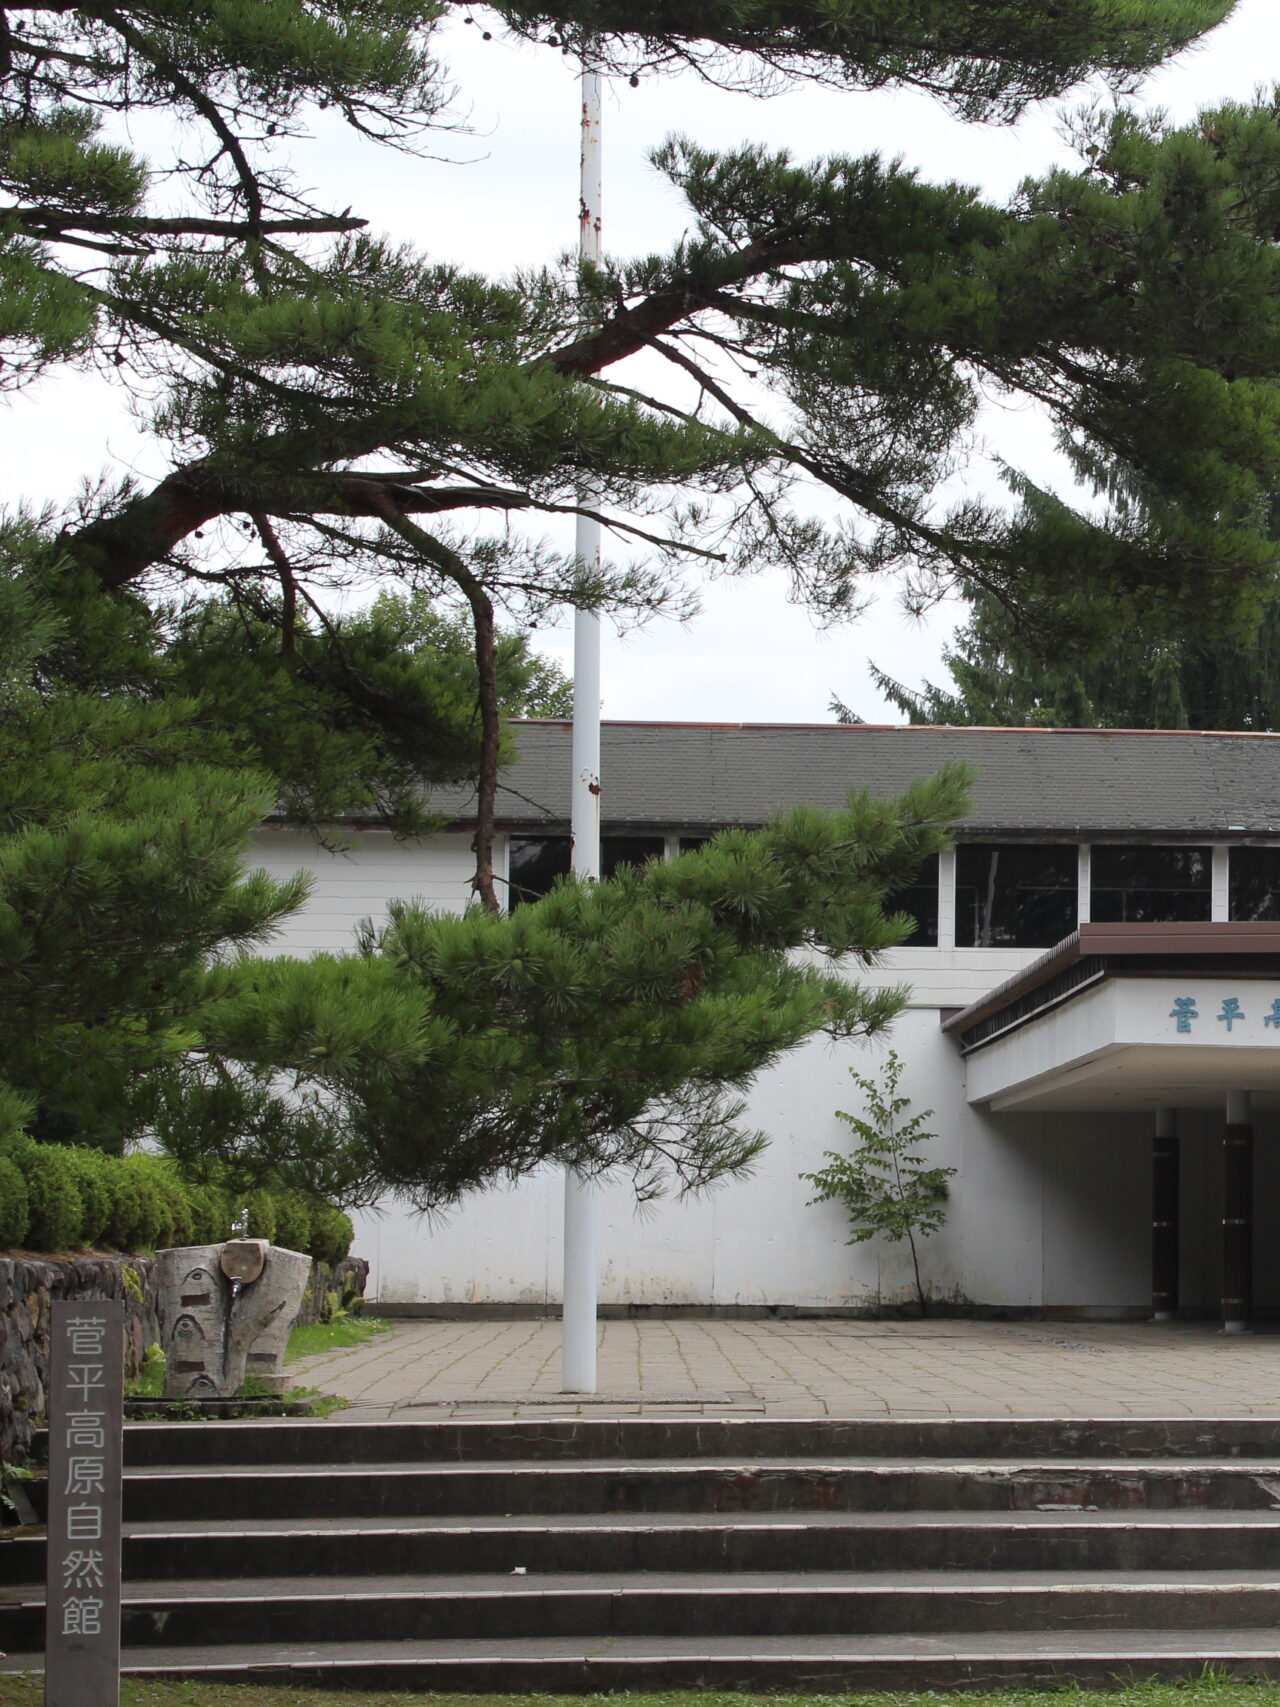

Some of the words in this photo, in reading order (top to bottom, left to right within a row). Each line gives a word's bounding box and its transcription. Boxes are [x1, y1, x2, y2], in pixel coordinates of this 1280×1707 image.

[61, 1316, 107, 1636] 菅平高原自然館
